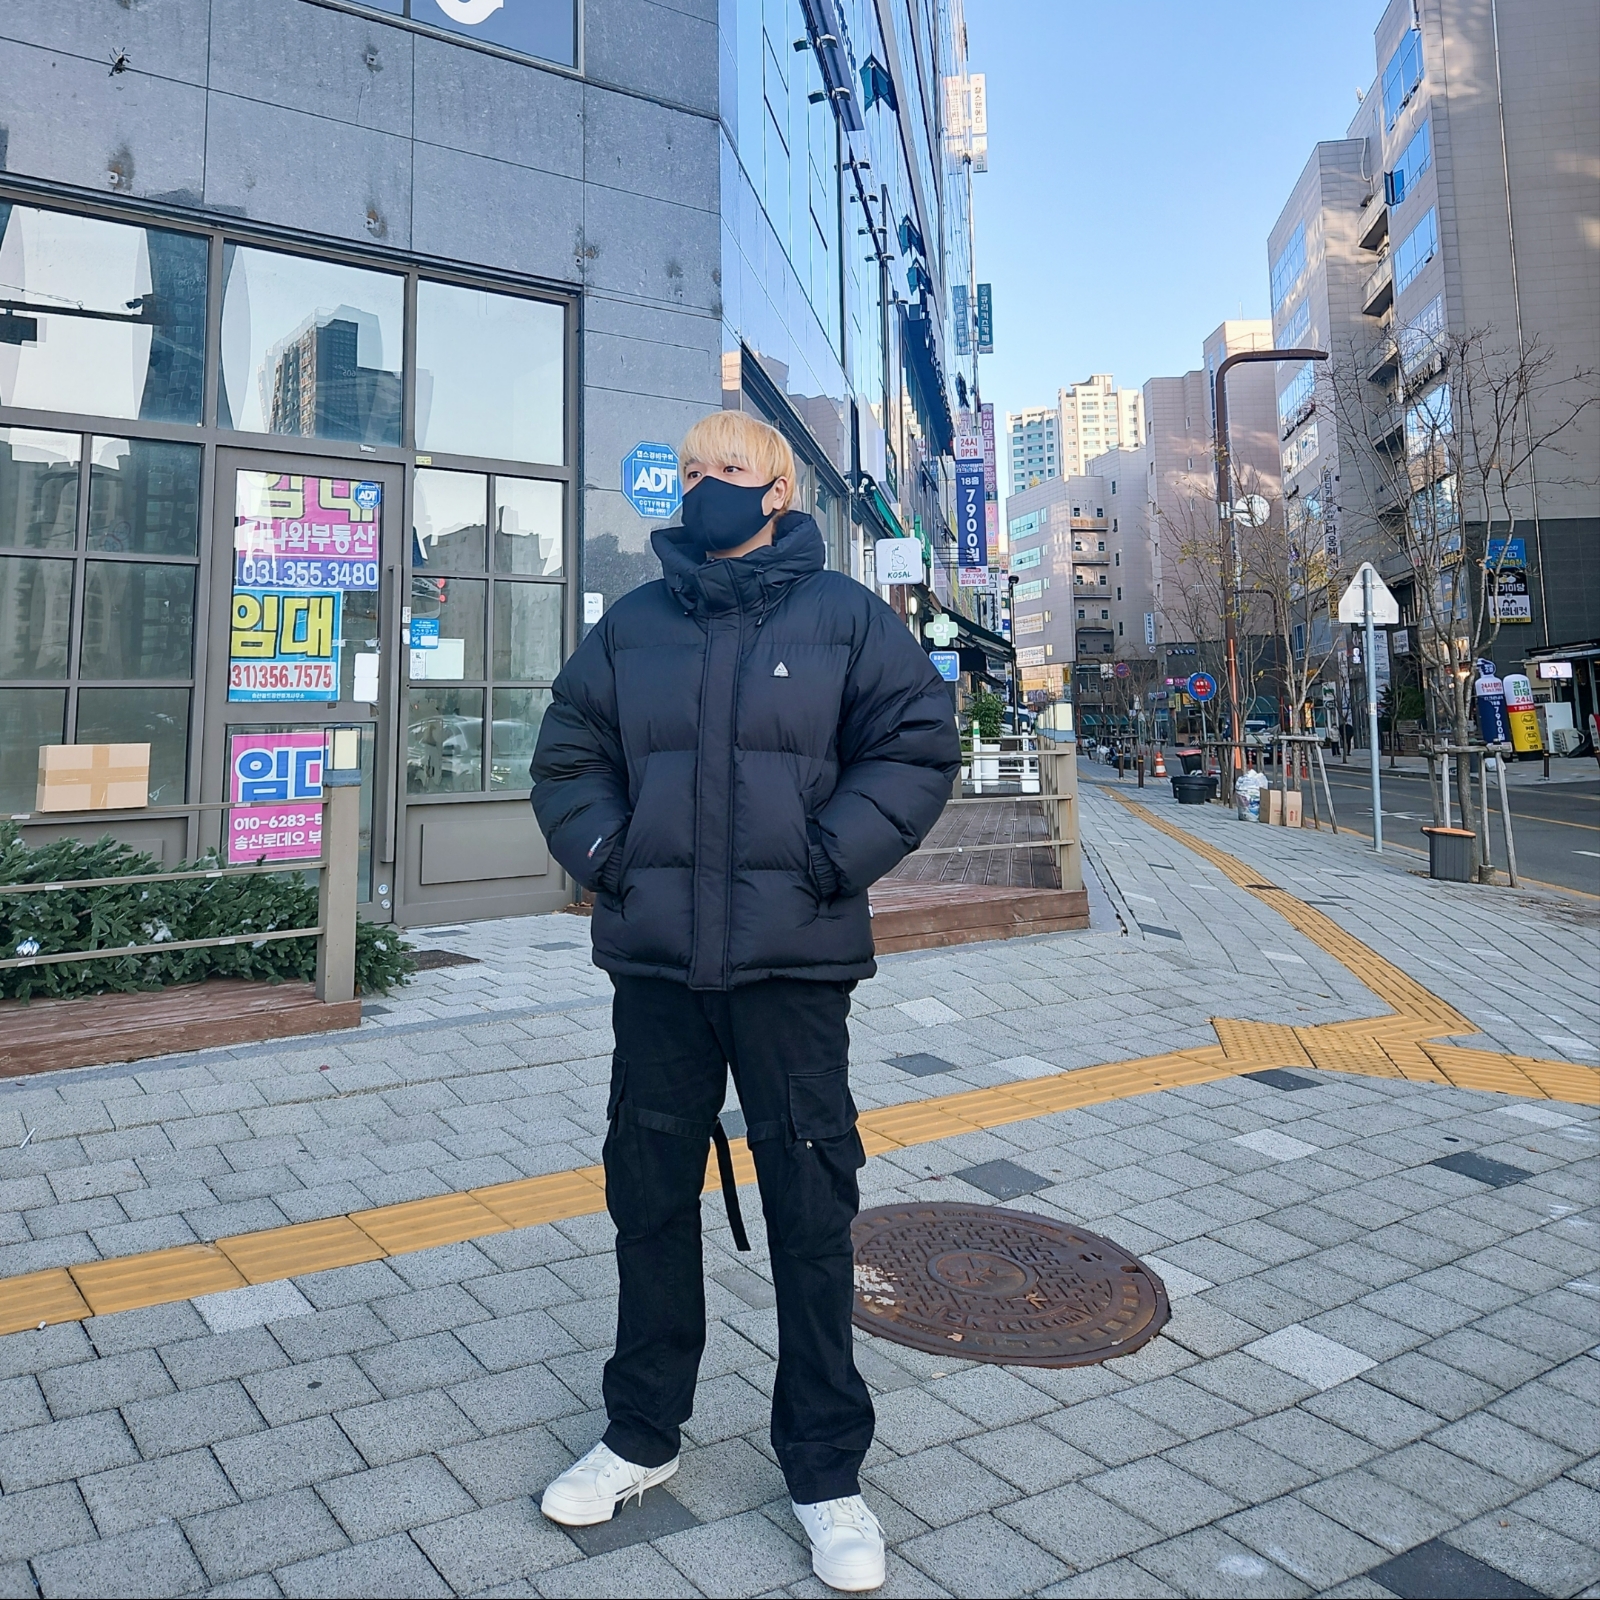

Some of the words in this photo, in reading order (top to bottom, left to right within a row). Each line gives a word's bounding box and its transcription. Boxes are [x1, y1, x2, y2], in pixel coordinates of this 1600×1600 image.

[960, 438, 978, 448] 24시
[960, 448, 978, 458] OPEN
[633, 466, 678, 494] ADT
[358, 490, 377, 501] ADT
[242, 560, 378, 586] 031.355.3480
[887, 571, 913, 579] KOSAL
[1491, 584, 1525, 592] 기미당
[231, 594, 334, 659] 임대
[933, 623, 950, 640] 약
[228, 664, 332, 689] 31)356.7575
[234, 831, 306, 851] 송산로데오
[946, 1310, 987, 1329] SK
[996, 1312, 1084, 1331] telecom
